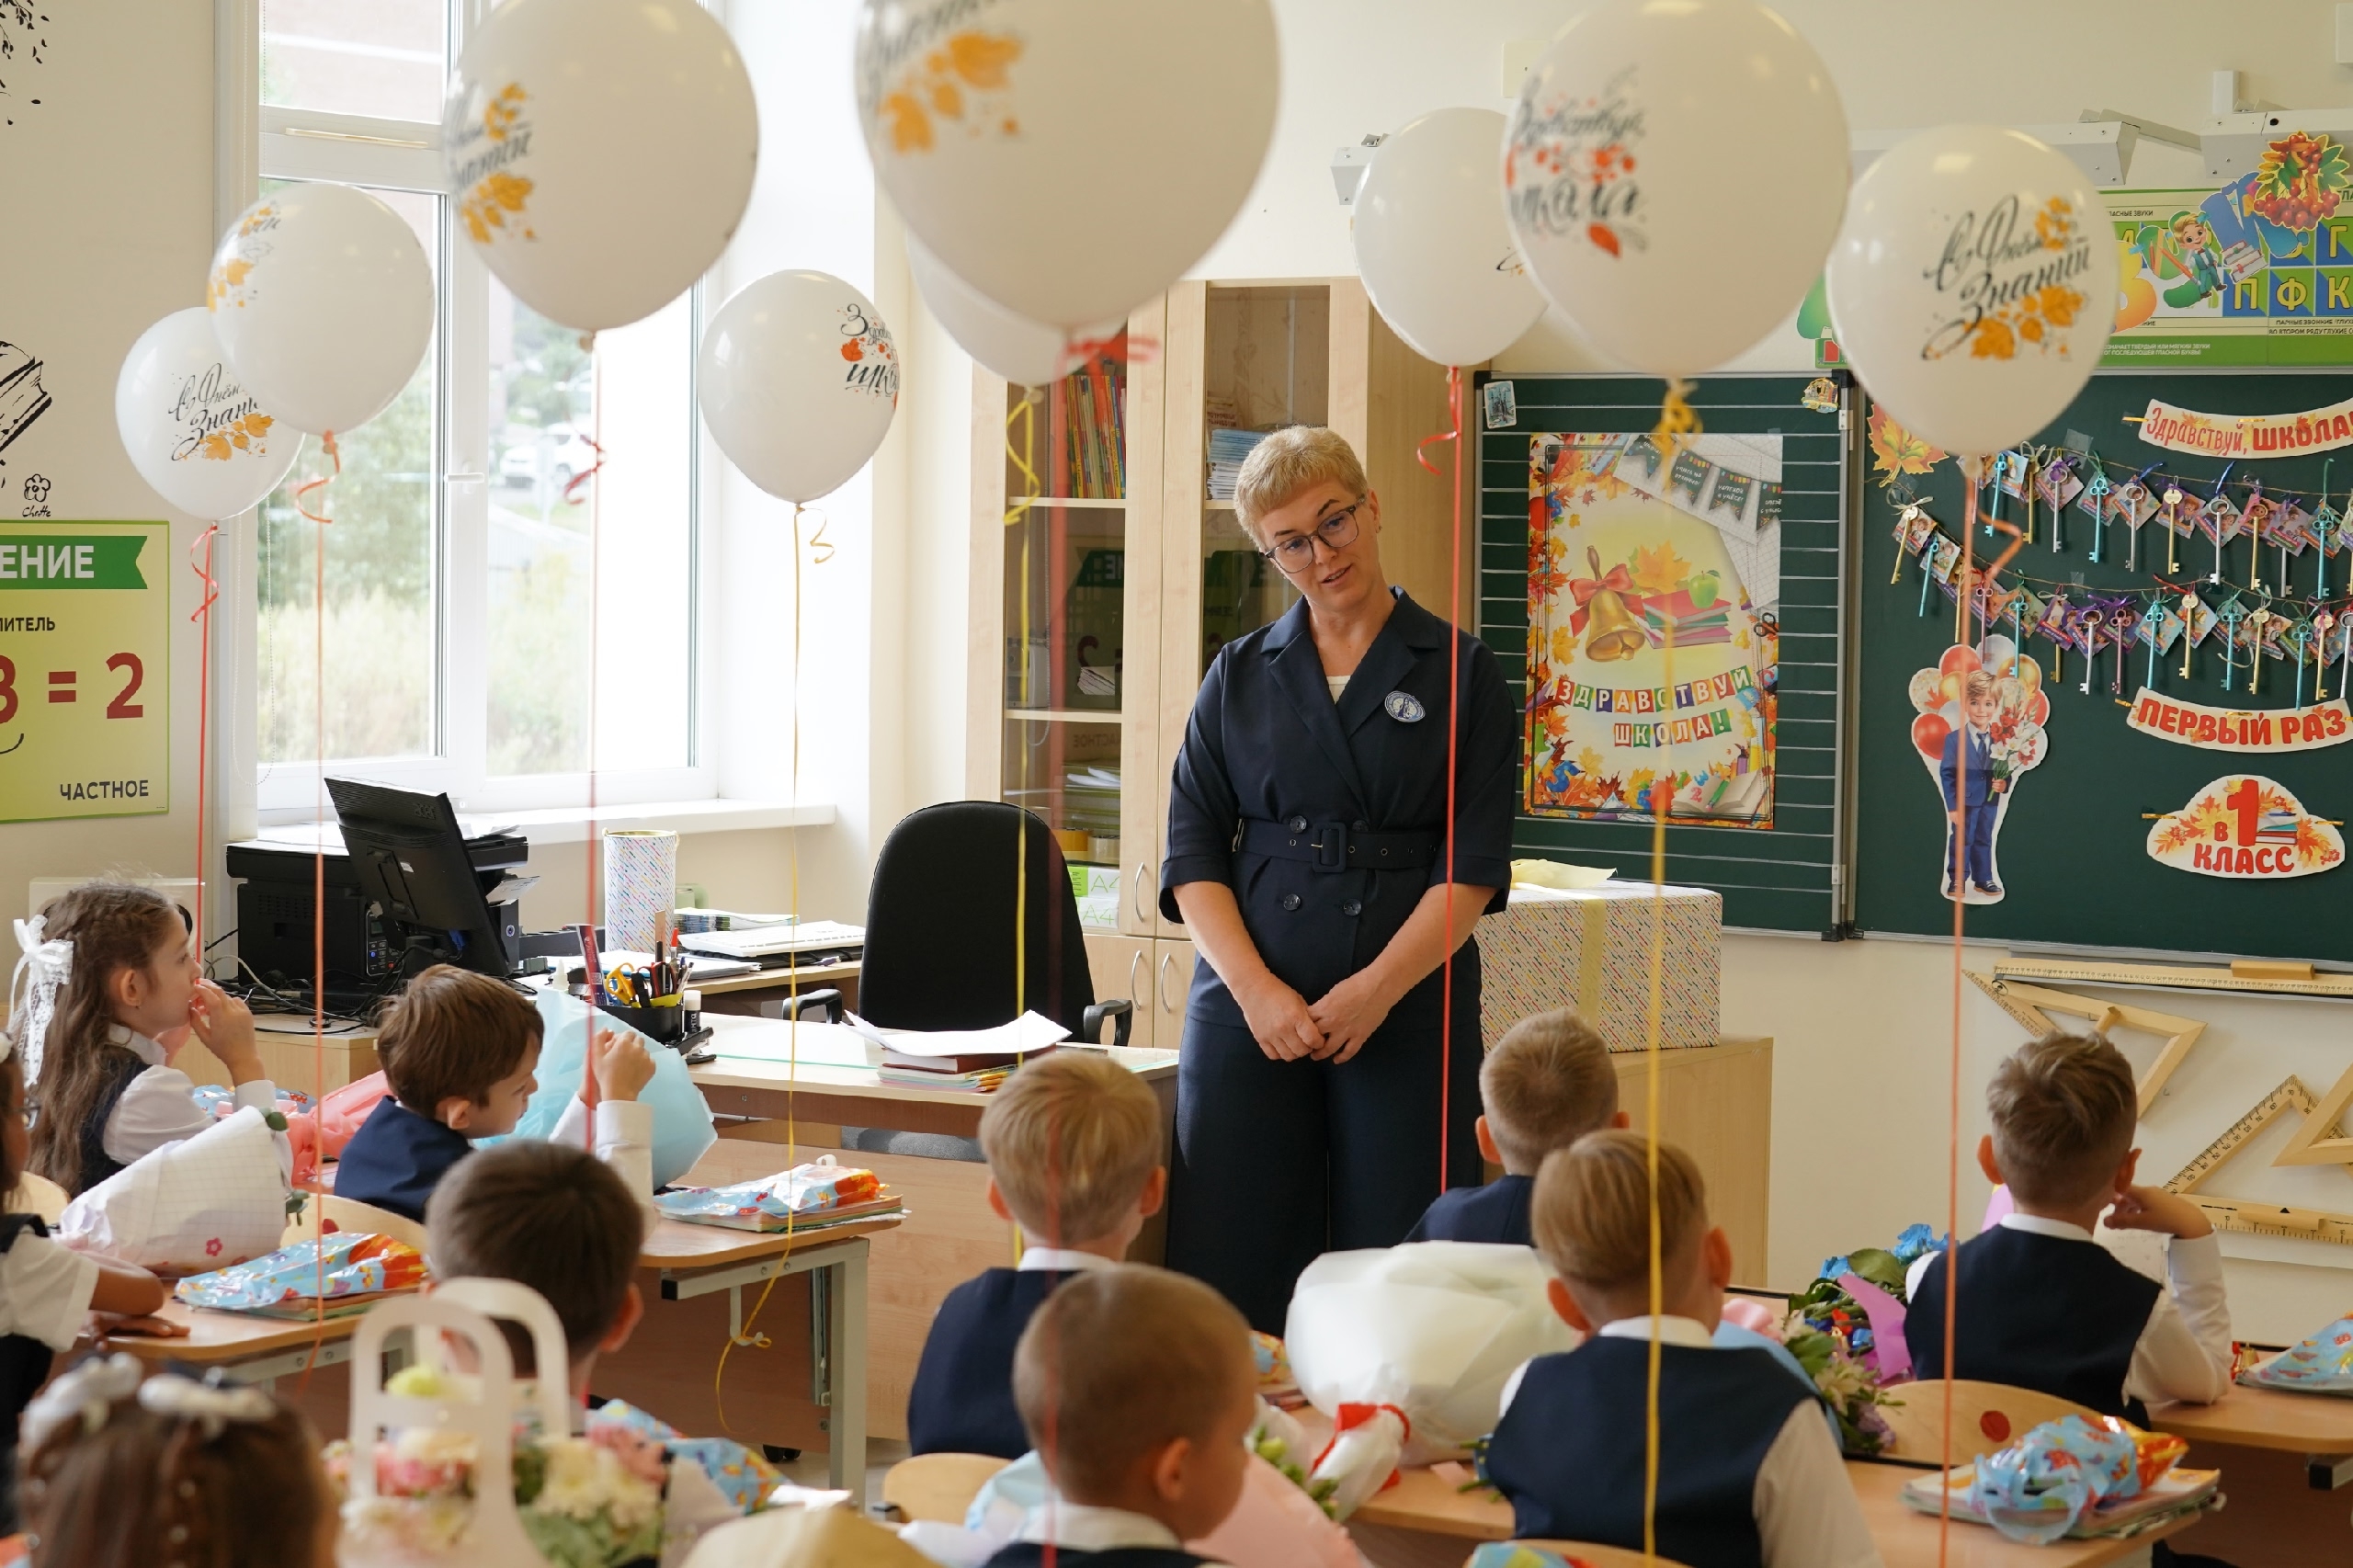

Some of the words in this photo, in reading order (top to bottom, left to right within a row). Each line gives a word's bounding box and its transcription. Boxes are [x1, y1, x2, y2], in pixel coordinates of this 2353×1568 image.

[2146, 406, 2249, 457] Здравствуй,
[106, 652, 144, 720] 2
[2137, 698, 2272, 746] ПЕРВЫЙ
[2279, 709, 2347, 744] РАЗ
[60, 779, 149, 801] ЧАСТНОЕ
[2193, 843, 2295, 874] КЛАСС
